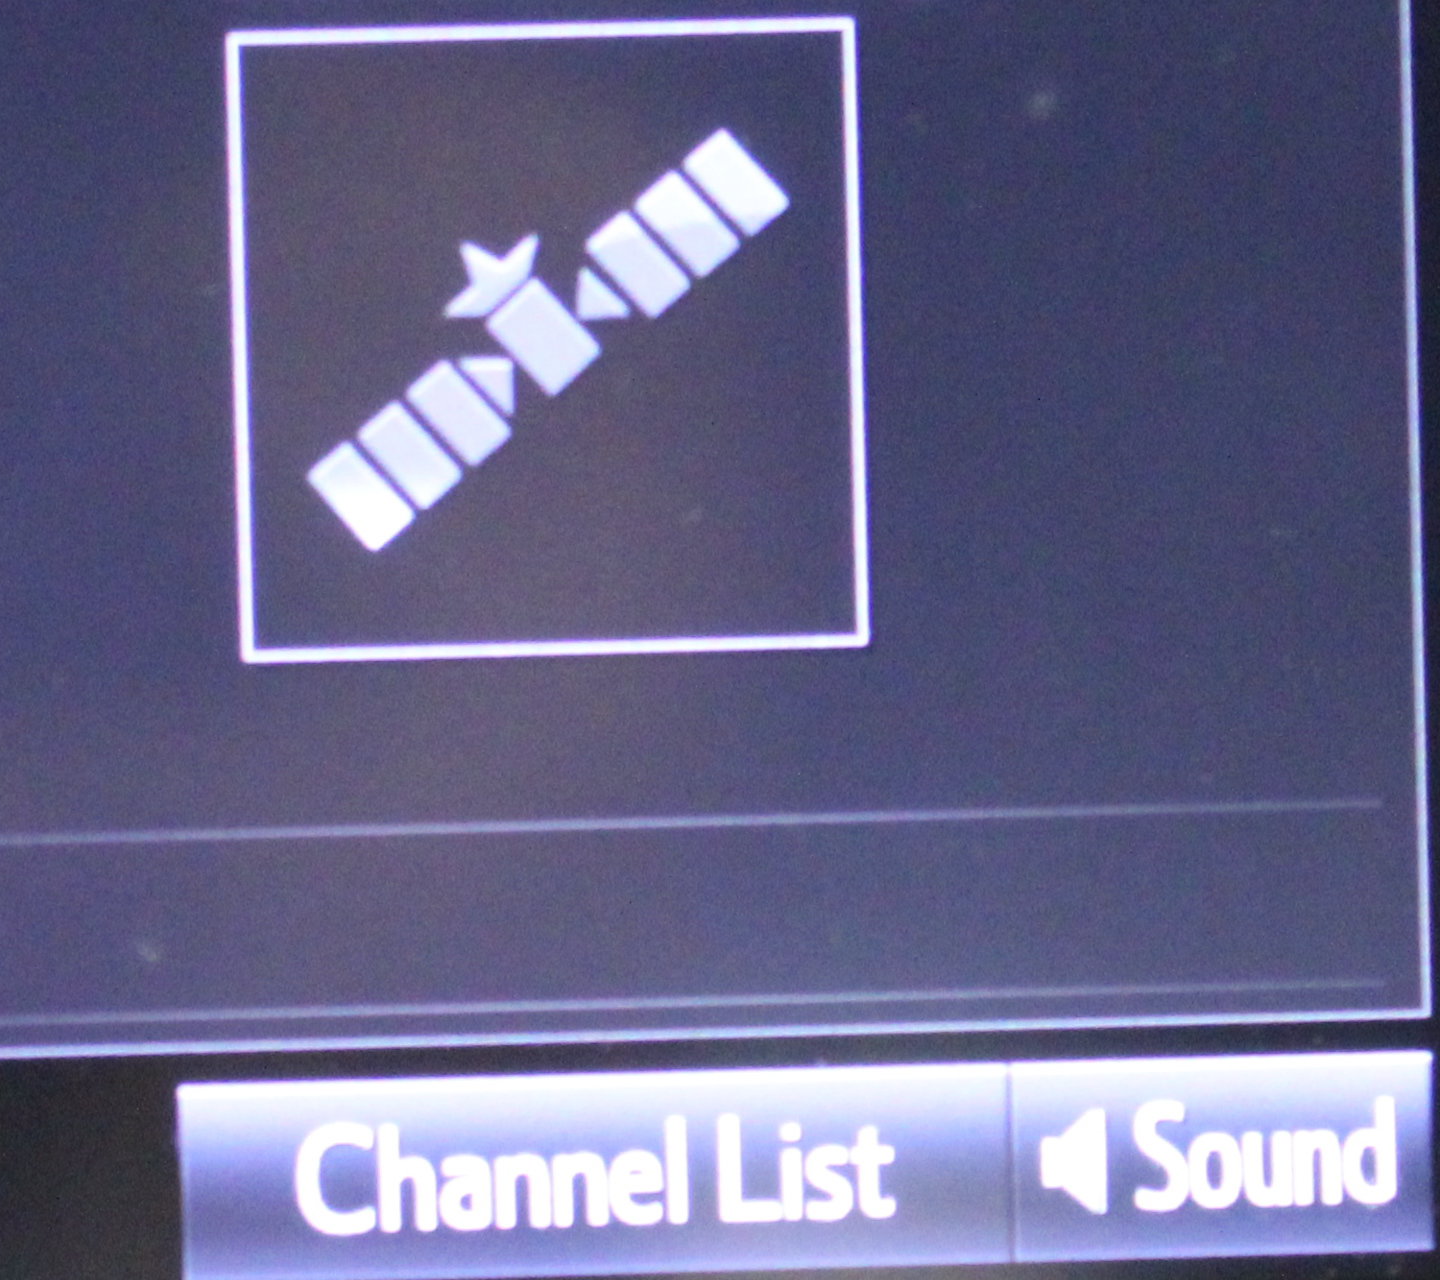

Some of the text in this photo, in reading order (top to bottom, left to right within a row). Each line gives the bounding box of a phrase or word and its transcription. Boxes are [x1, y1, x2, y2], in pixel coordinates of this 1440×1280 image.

[293, 1108, 899, 1236] Channel List
[1129, 1096, 1399, 1214] Sound
